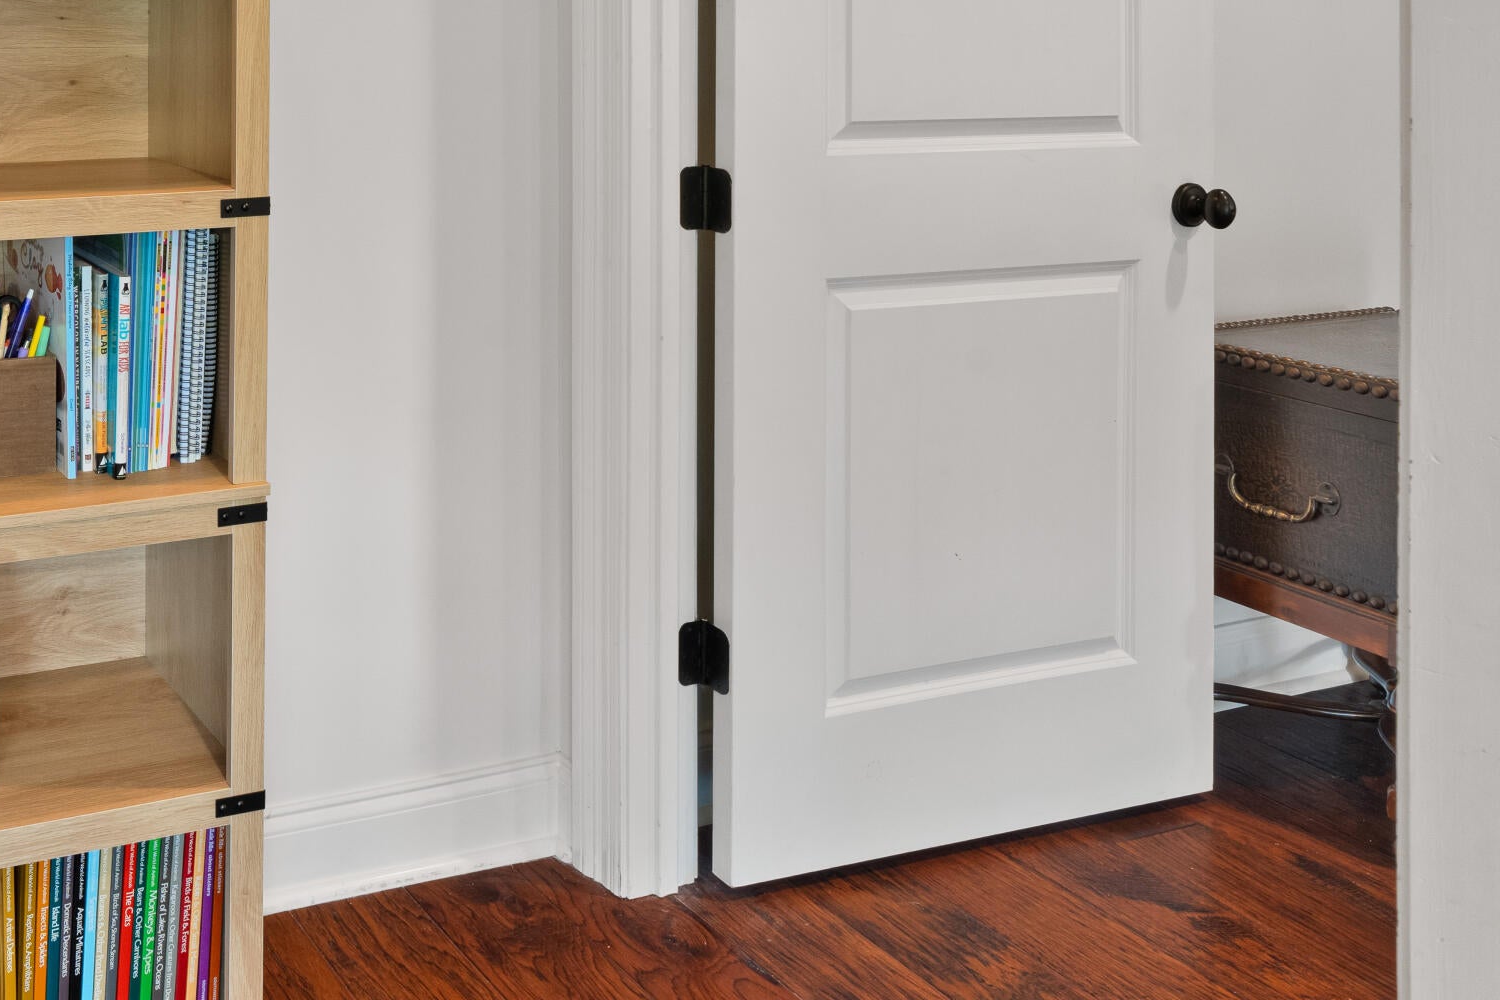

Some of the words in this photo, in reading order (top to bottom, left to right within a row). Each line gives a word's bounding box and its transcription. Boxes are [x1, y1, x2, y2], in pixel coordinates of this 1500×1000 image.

[119, 304, 130, 315] ART
[119, 318, 130, 339] lab
[119, 341, 129, 355] FOR
[118, 357, 129, 373] KIDS
[136, 886, 144, 907] Bears
[159, 882, 169, 903] Fishes
[184, 877, 192, 895] Birds
[125, 889, 134, 906] The
[159, 904, 167, 912] of
[39, 906, 48, 931] Insects
[51, 906, 60, 928] Island
[62, 902, 71, 934] Domestic
[75, 907, 84, 936] Aquatic
[124, 907, 133, 927] Cats
[135, 908, 143, 916] &
[144, 889, 157, 935] Monkeys
[182, 904, 191, 921] Field
[25, 913, 33, 940] Reptiles
[51, 929, 59, 942] Life
[134, 917, 143, 938] Other
[145, 936, 154, 946] &
[156, 934, 165, 956] Rivers
[180, 931, 189, 954] Forest
[38, 942, 47, 968] Spiders
[61, 935, 70, 978] Descendants
[74, 937, 83, 976] Miniatures
[132, 939, 142, 979] Carnivores
[143, 948, 153, 975] Apes
[24, 951, 32, 992] Amphibians
[154, 965, 163, 990] Oceans
